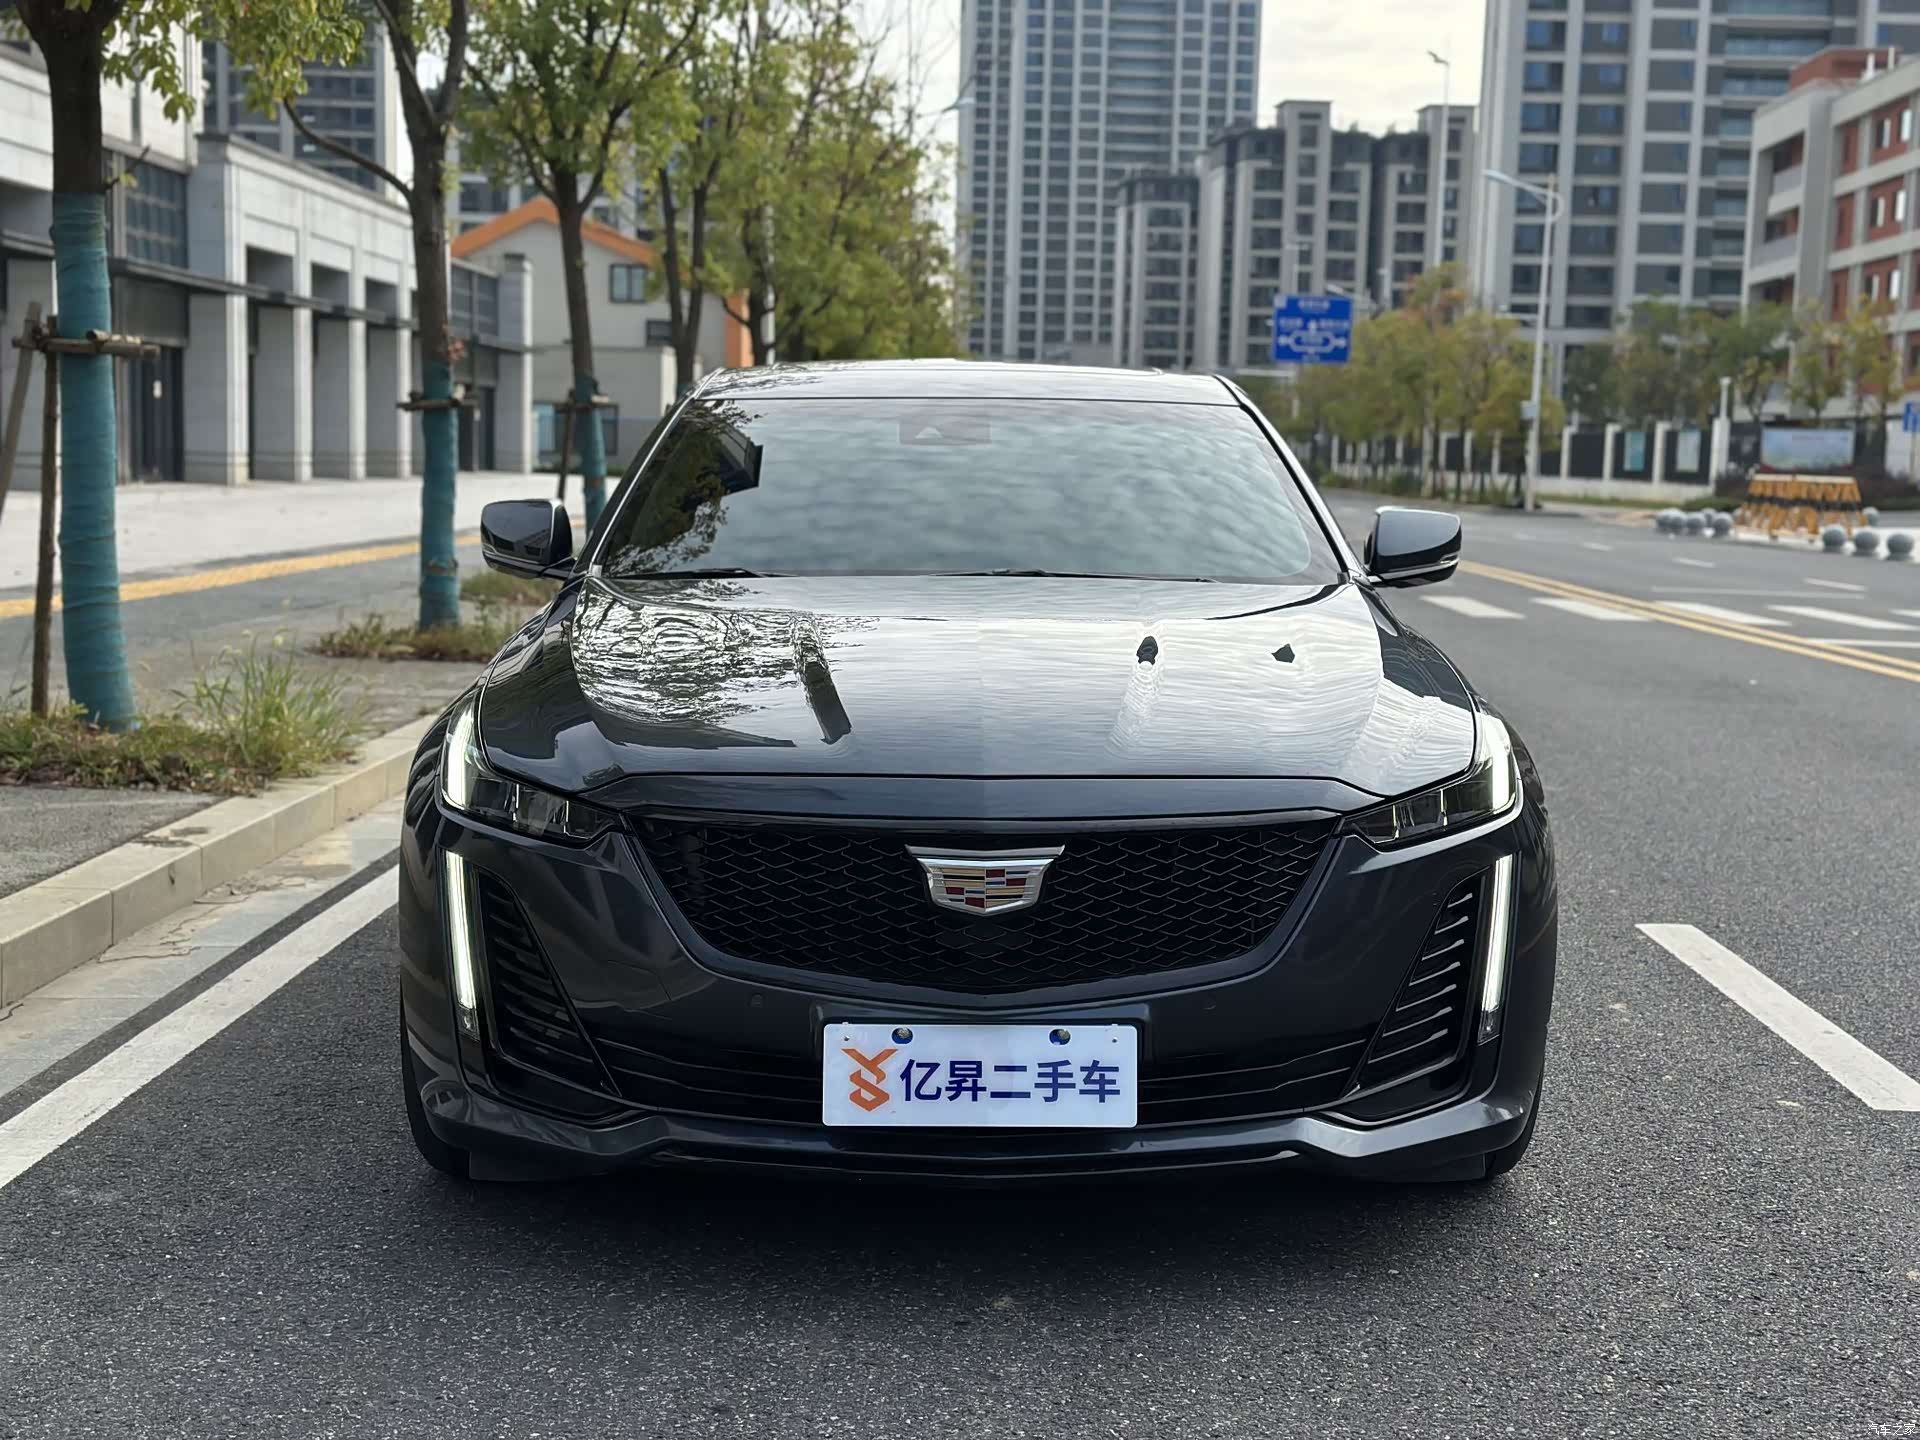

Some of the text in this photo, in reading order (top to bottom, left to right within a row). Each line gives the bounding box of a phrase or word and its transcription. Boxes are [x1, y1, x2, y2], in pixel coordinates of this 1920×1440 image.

[899, 1059, 1121, 1103] 亿昇二手车
